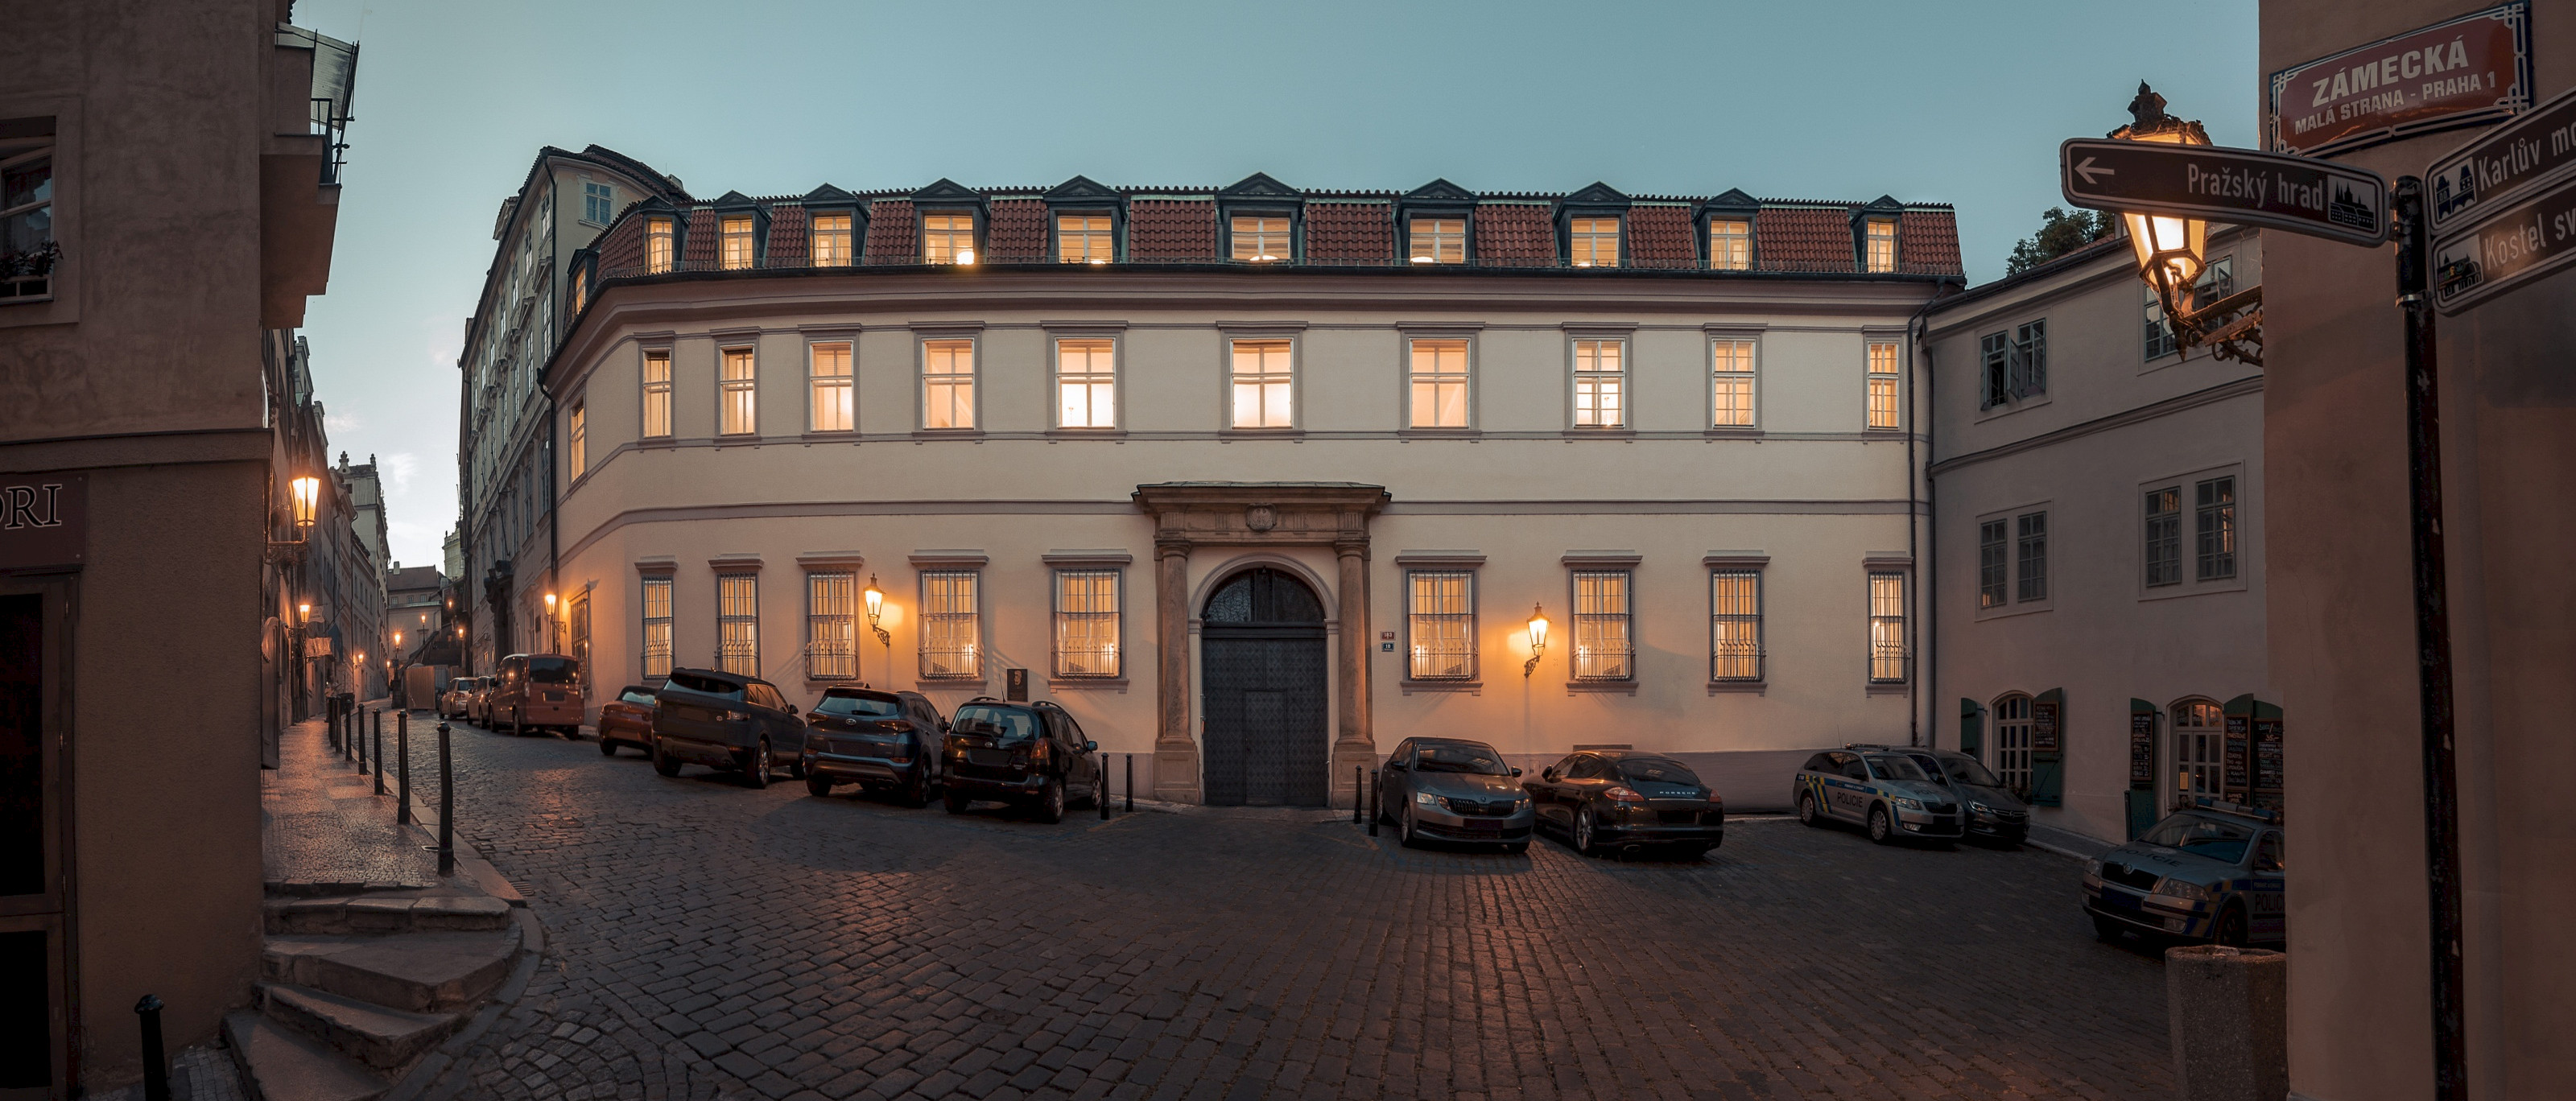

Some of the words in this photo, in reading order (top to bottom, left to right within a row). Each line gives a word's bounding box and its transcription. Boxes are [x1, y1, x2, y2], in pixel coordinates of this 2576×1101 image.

[2313, 35, 2469, 108] ZÁMECKÁ
[2295, 105, 2336, 135] MALÁ
[2340, 89, 2405, 121] STRANA
[2422, 73, 2482, 101] PRAHA
[2487, 71, 2496, 89] 1
[2187, 163, 2268, 209] Pražský
[2277, 172, 2323, 212] hrad
[2478, 137, 2541, 192] Karlův
[2484, 212, 2547, 271] Kostel
[0, 484, 63, 530] RI
[1837, 792, 1864, 807] POLICIE
[2116, 848, 2183, 867] POLICIE
[2255, 893, 2285, 911] POLICI
